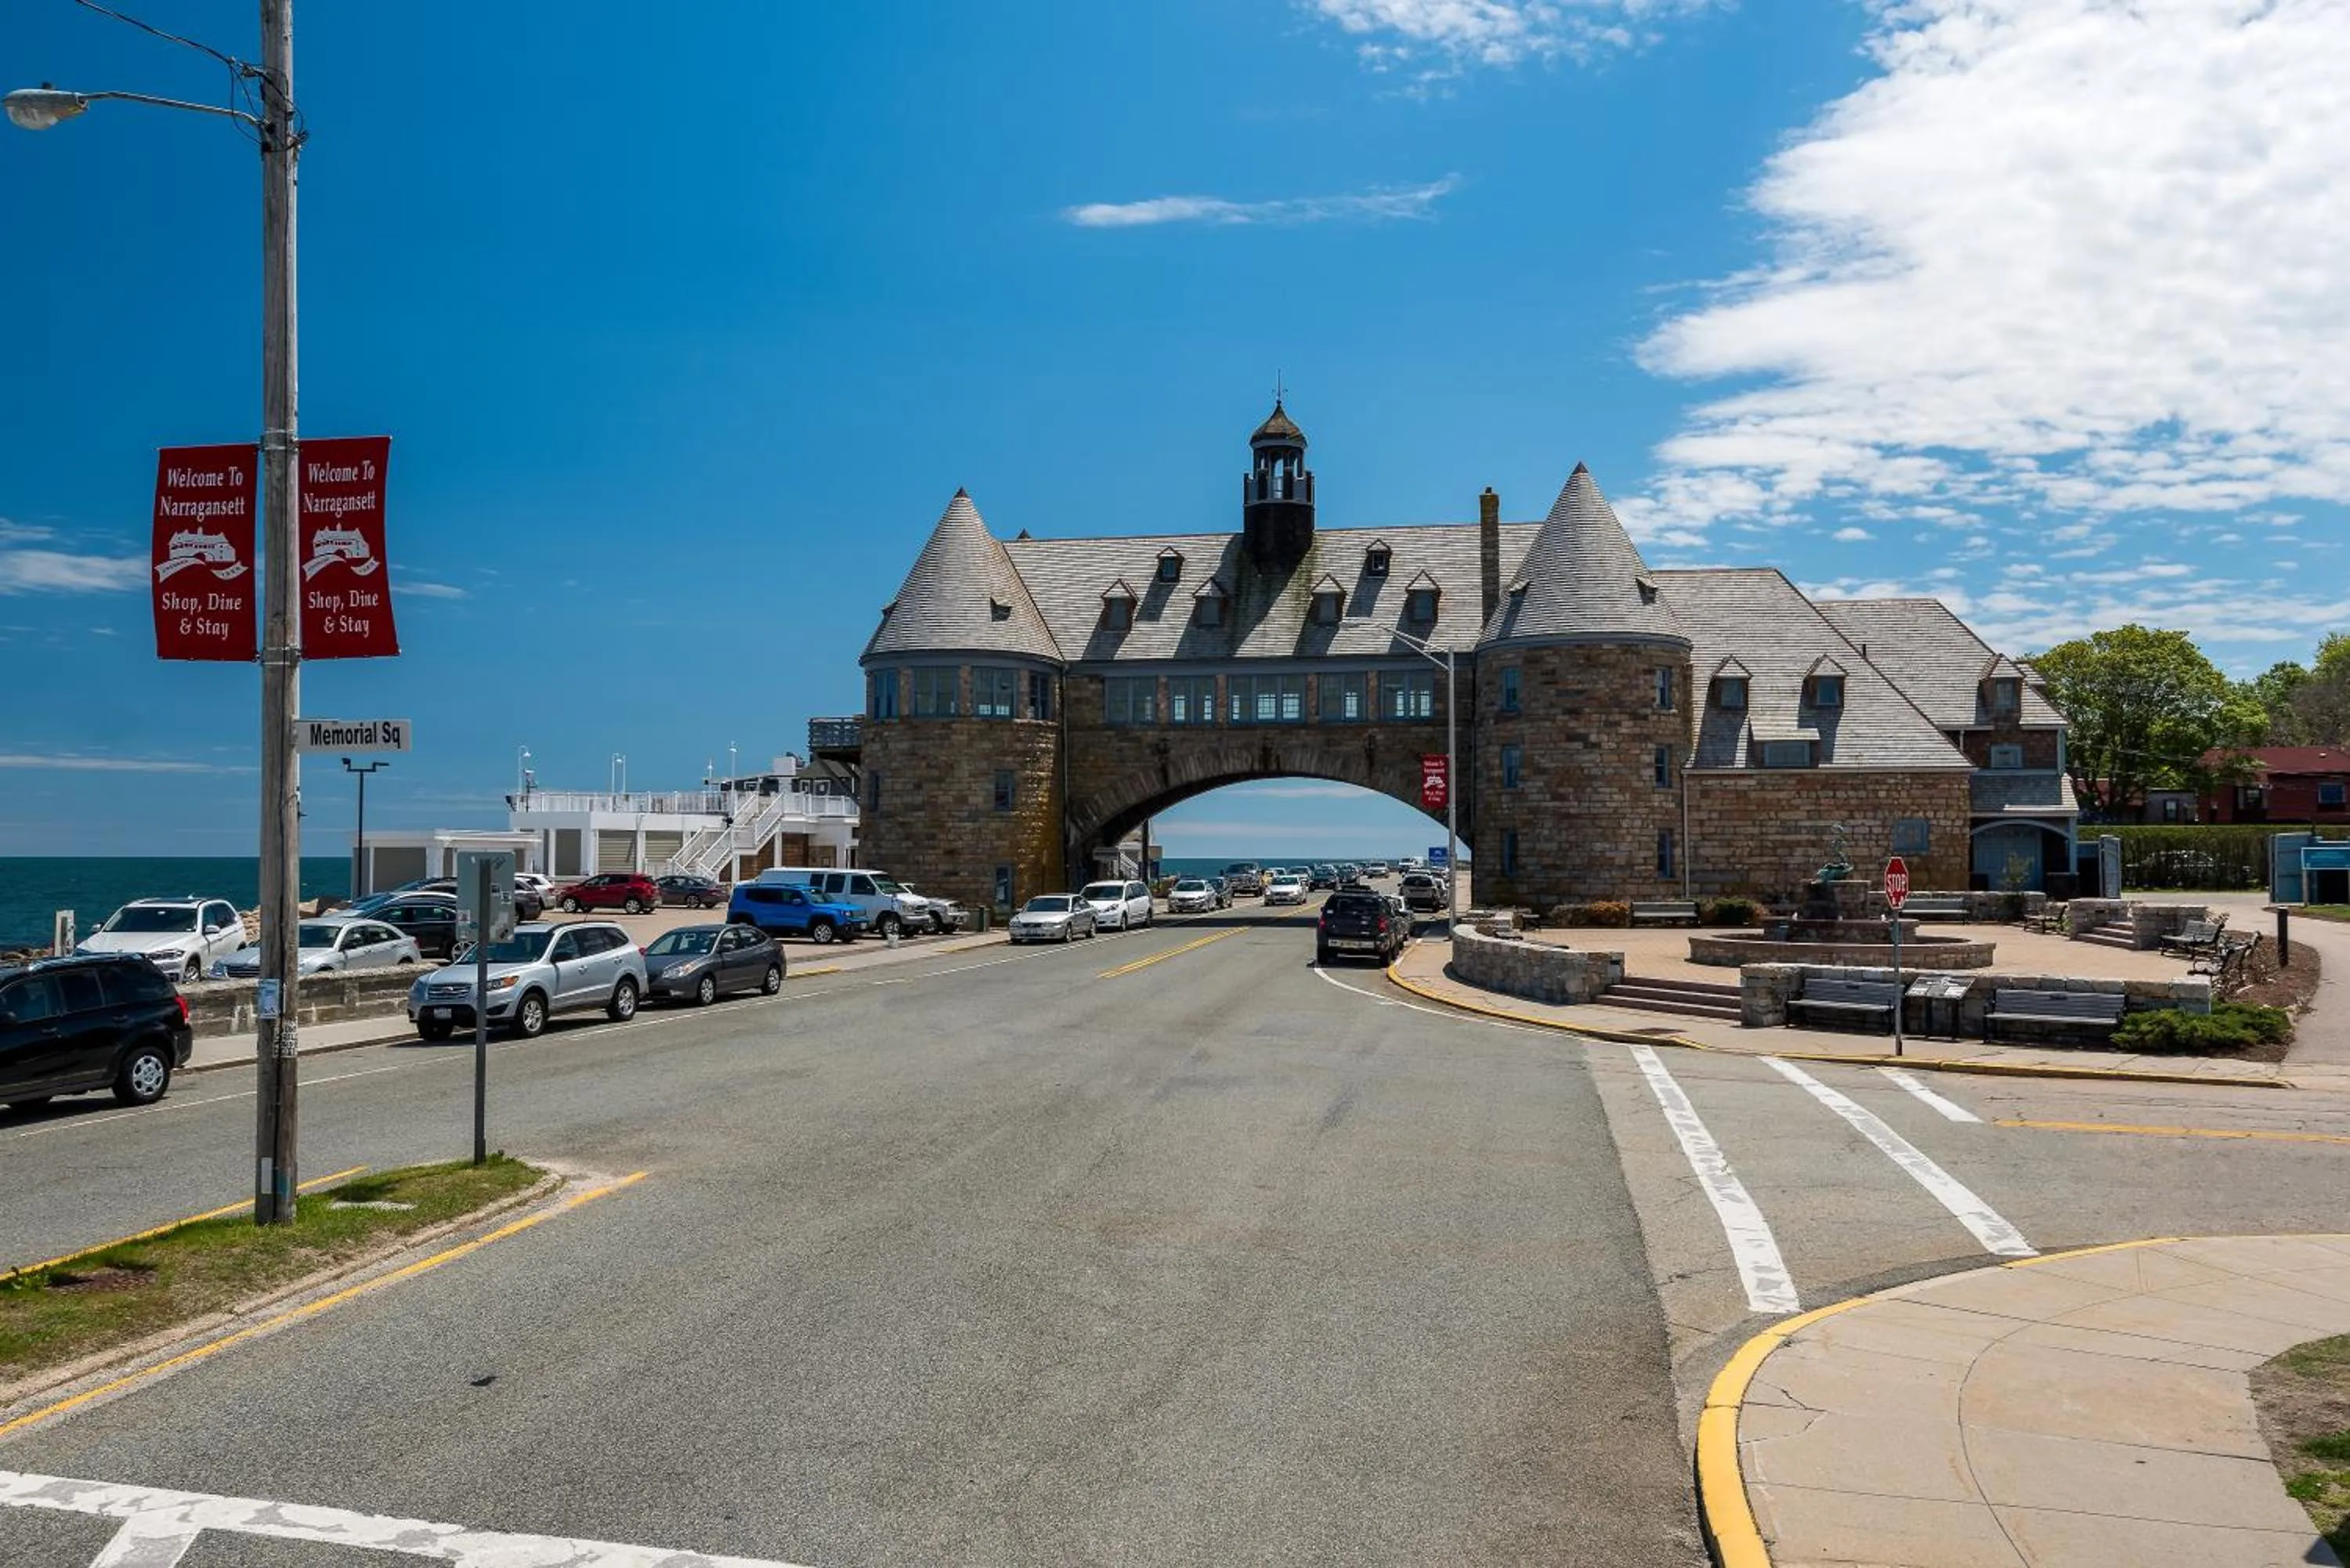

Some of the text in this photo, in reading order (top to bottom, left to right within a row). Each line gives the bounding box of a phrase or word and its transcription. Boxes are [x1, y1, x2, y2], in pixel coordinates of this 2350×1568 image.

[167, 466, 244, 488] Welcome To
[308, 460, 376, 483] Welcome To
[159, 496, 245, 522] Narragansett
[303, 490, 376, 518] Narragansett
[161, 592, 242, 613] Shop, Dine
[308, 589, 379, 612] Shop, Dine
[179, 617, 230, 641] & Stay
[324, 615, 370, 638] & Stay
[310, 721, 402, 750] Memorial Sq
[1887, 873, 1906, 892] STOP
